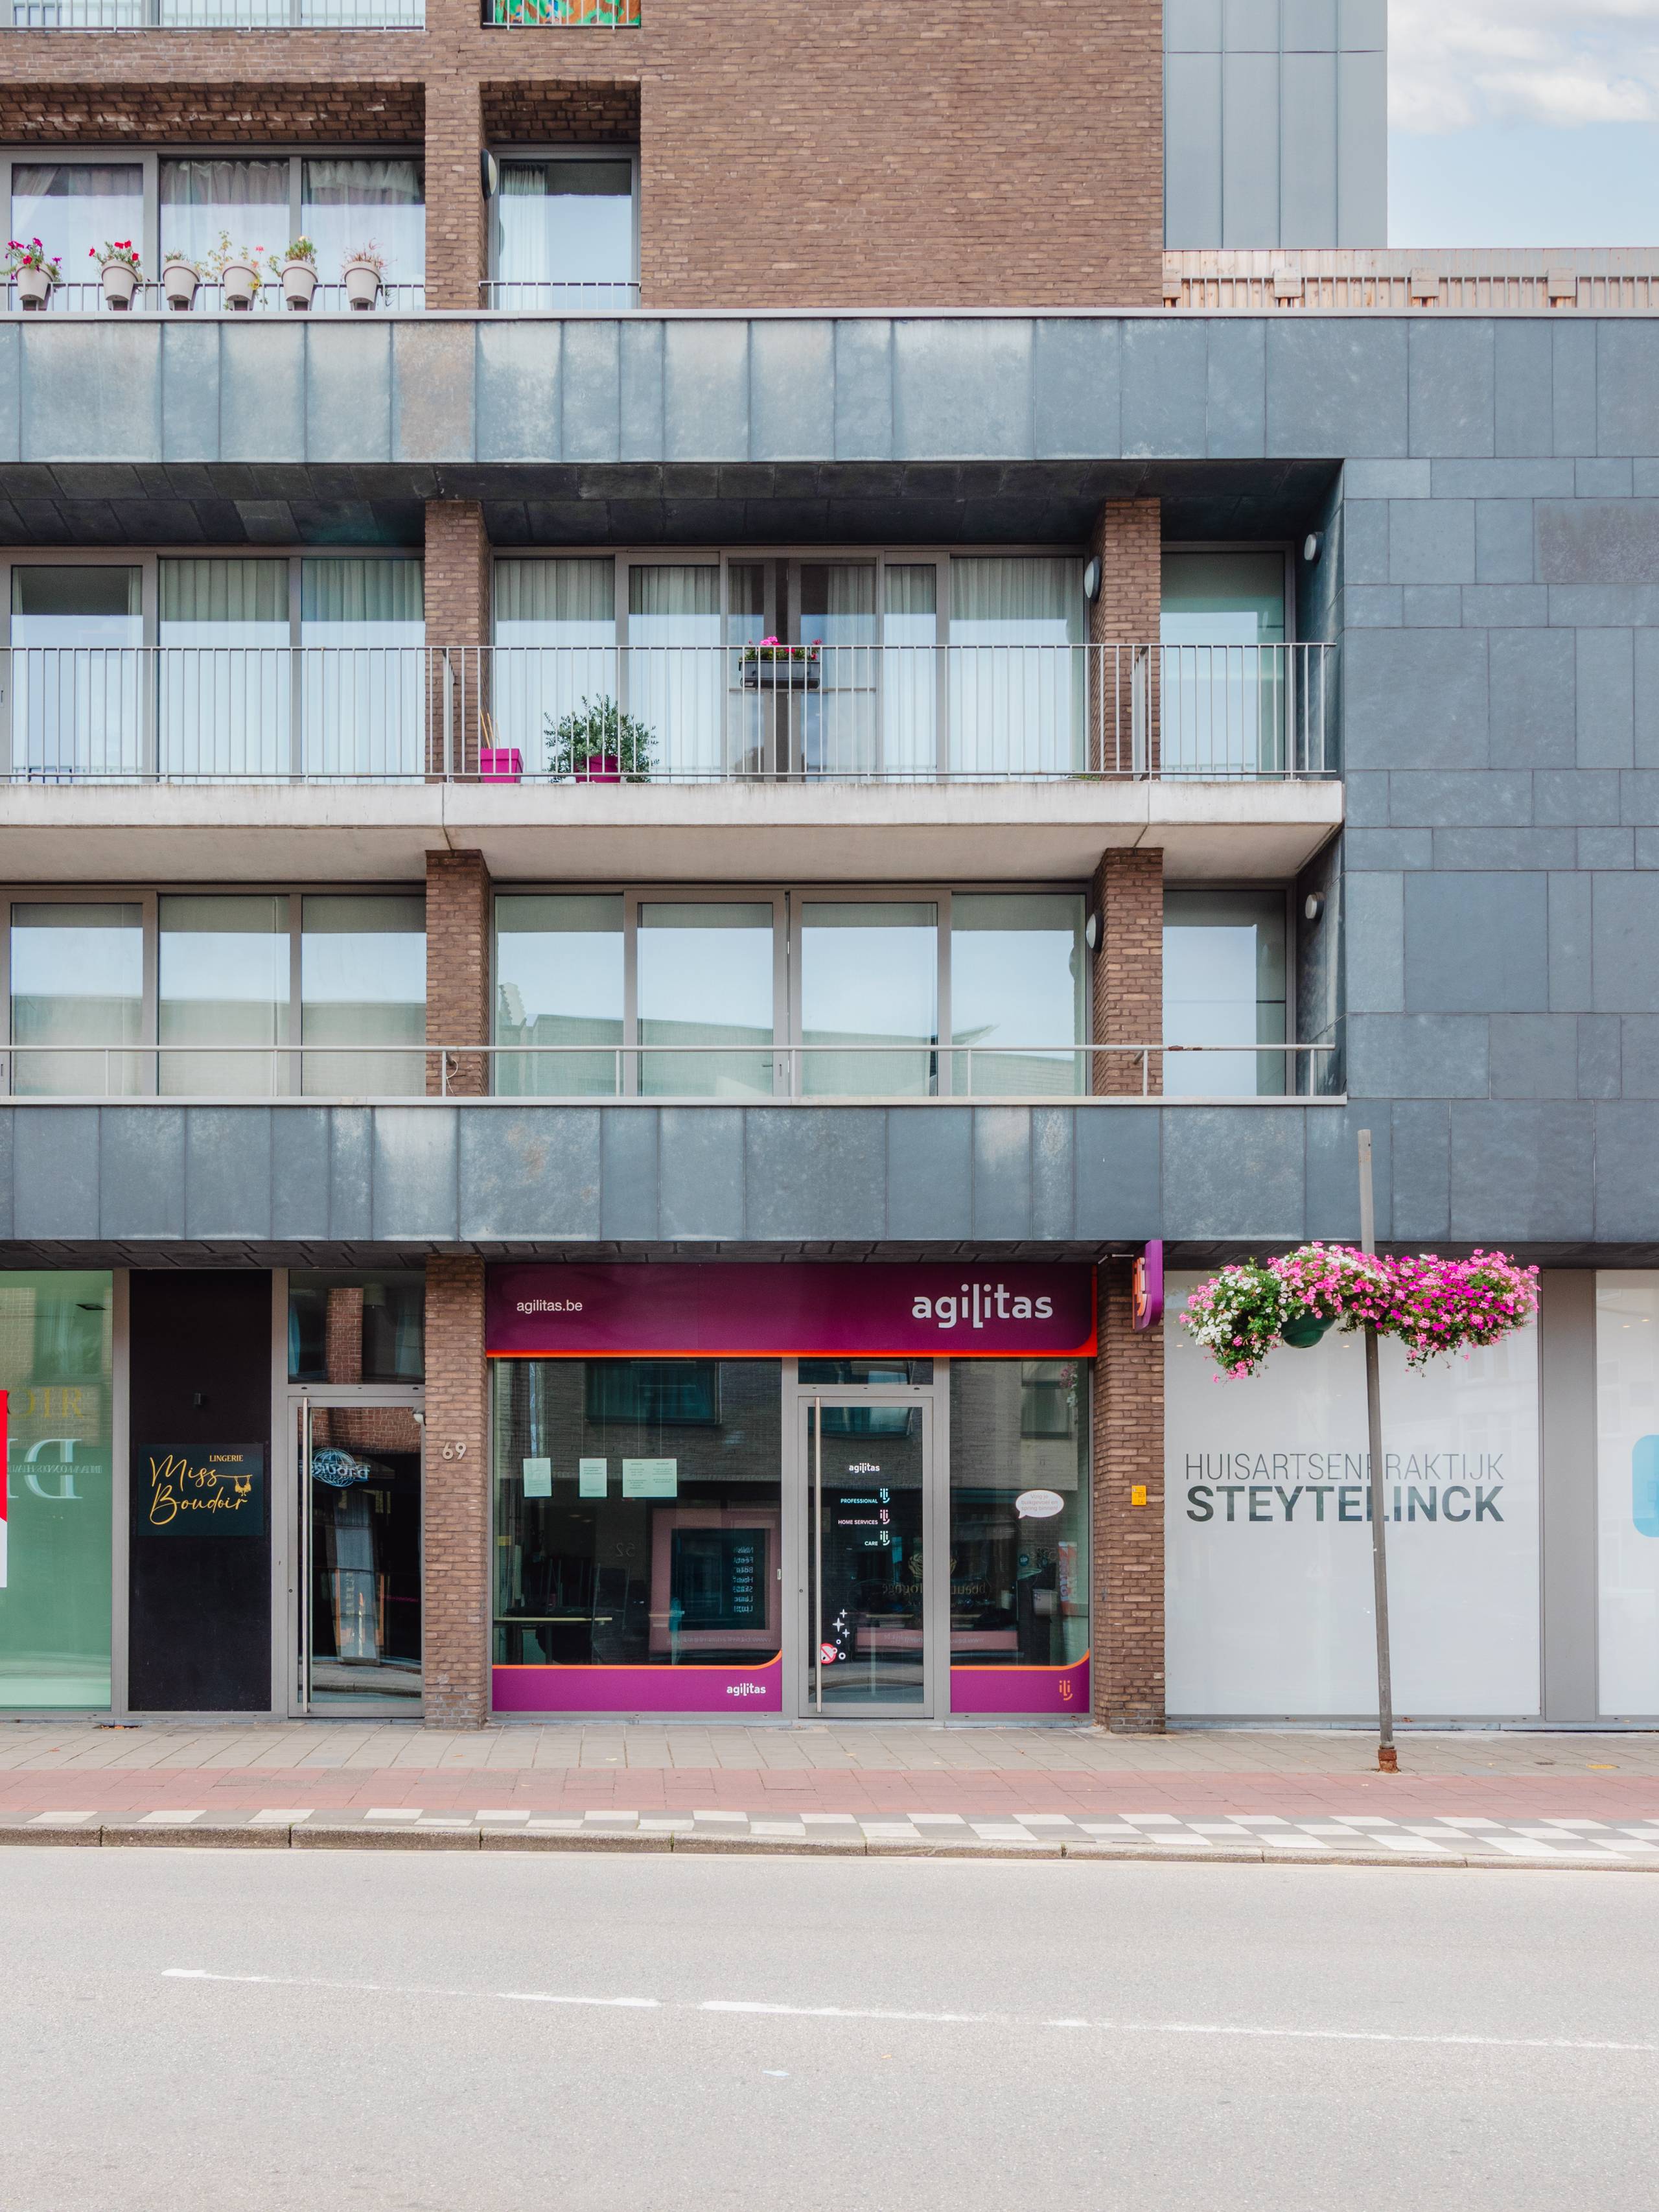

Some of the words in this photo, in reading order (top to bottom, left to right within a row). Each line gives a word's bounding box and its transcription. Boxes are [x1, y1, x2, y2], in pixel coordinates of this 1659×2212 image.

[516, 1299, 583, 1314] agilitas.be
[912, 1284, 1053, 1328] agilitas
[442, 1441, 467, 1460] 69
[150, 1454, 219, 1491] Miss
[849, 1463, 880, 1473] agilitas
[150, 1483, 248, 1524] Boudoir
[726, 1683, 766, 1696] agilitas
